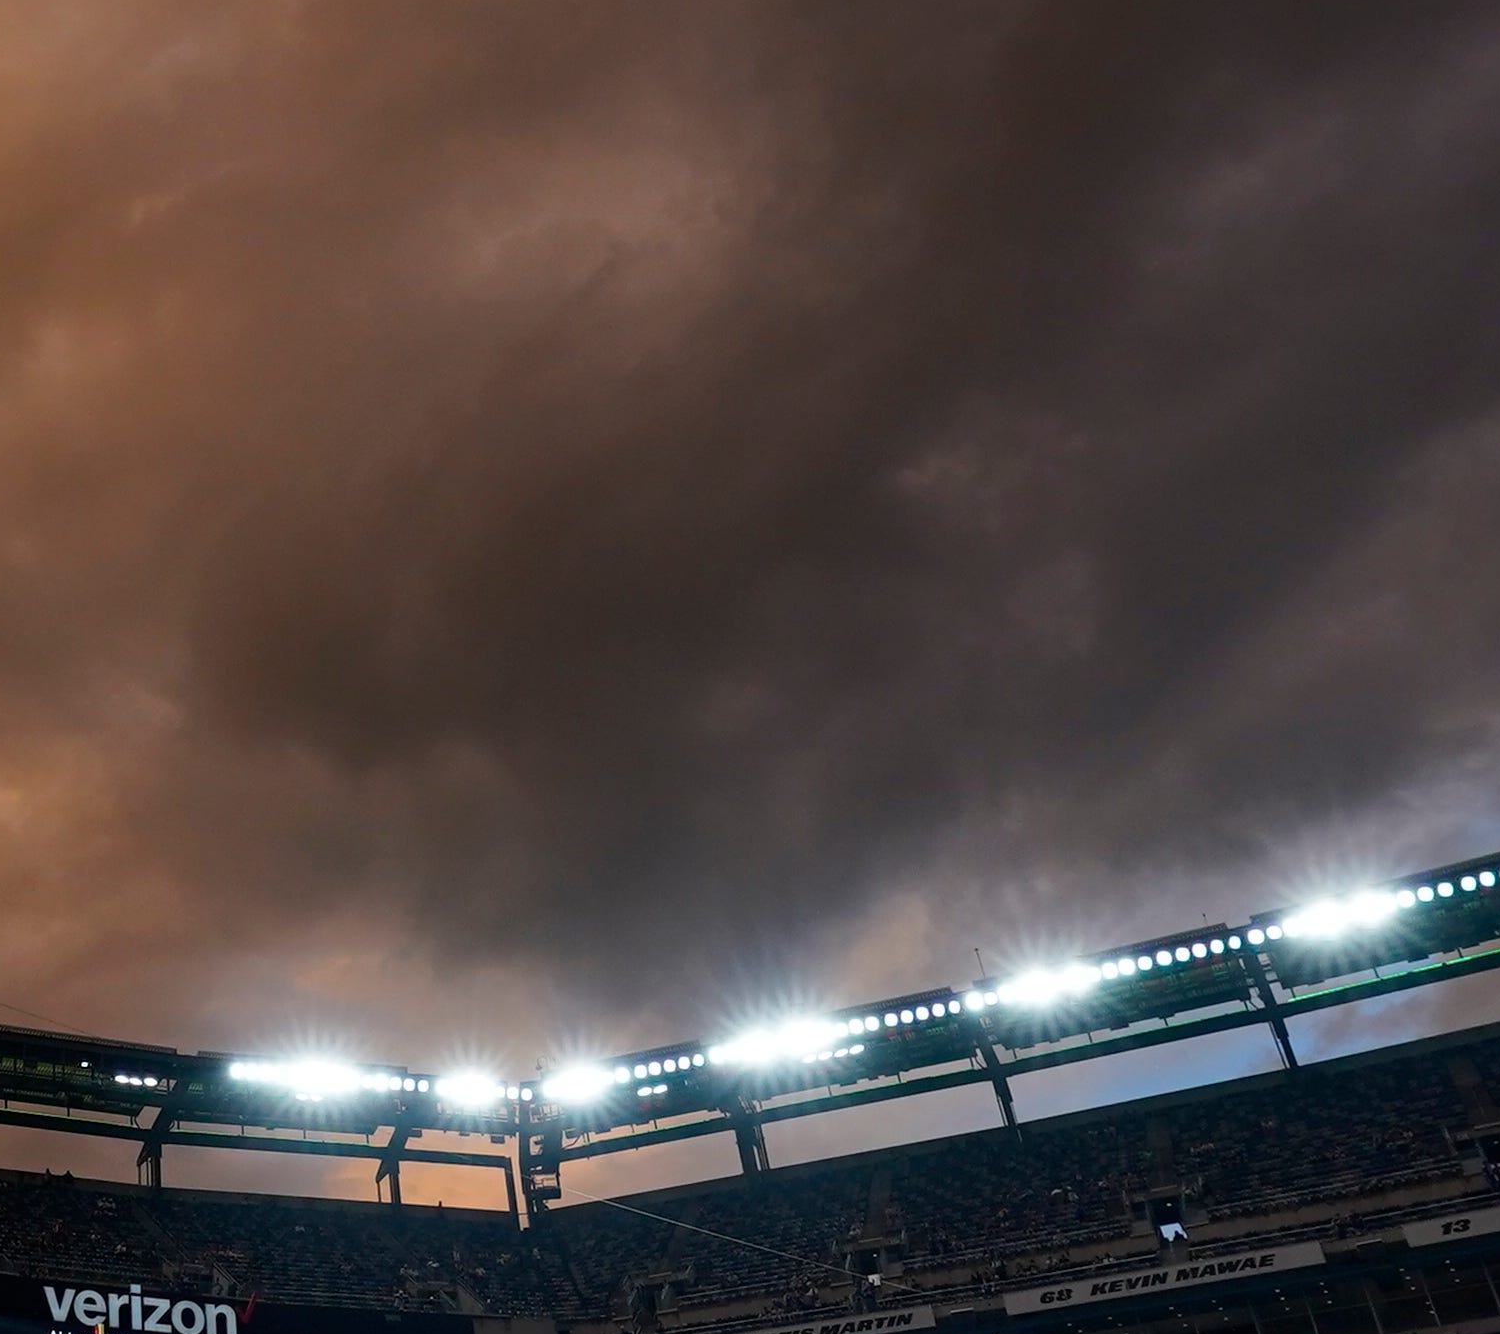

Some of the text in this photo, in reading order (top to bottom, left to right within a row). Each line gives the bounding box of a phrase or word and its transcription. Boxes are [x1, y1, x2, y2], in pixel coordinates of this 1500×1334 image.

[1441, 1218, 1472, 1236] 13
[1039, 1255, 1276, 1305] 68 KEVIN MAWAE
